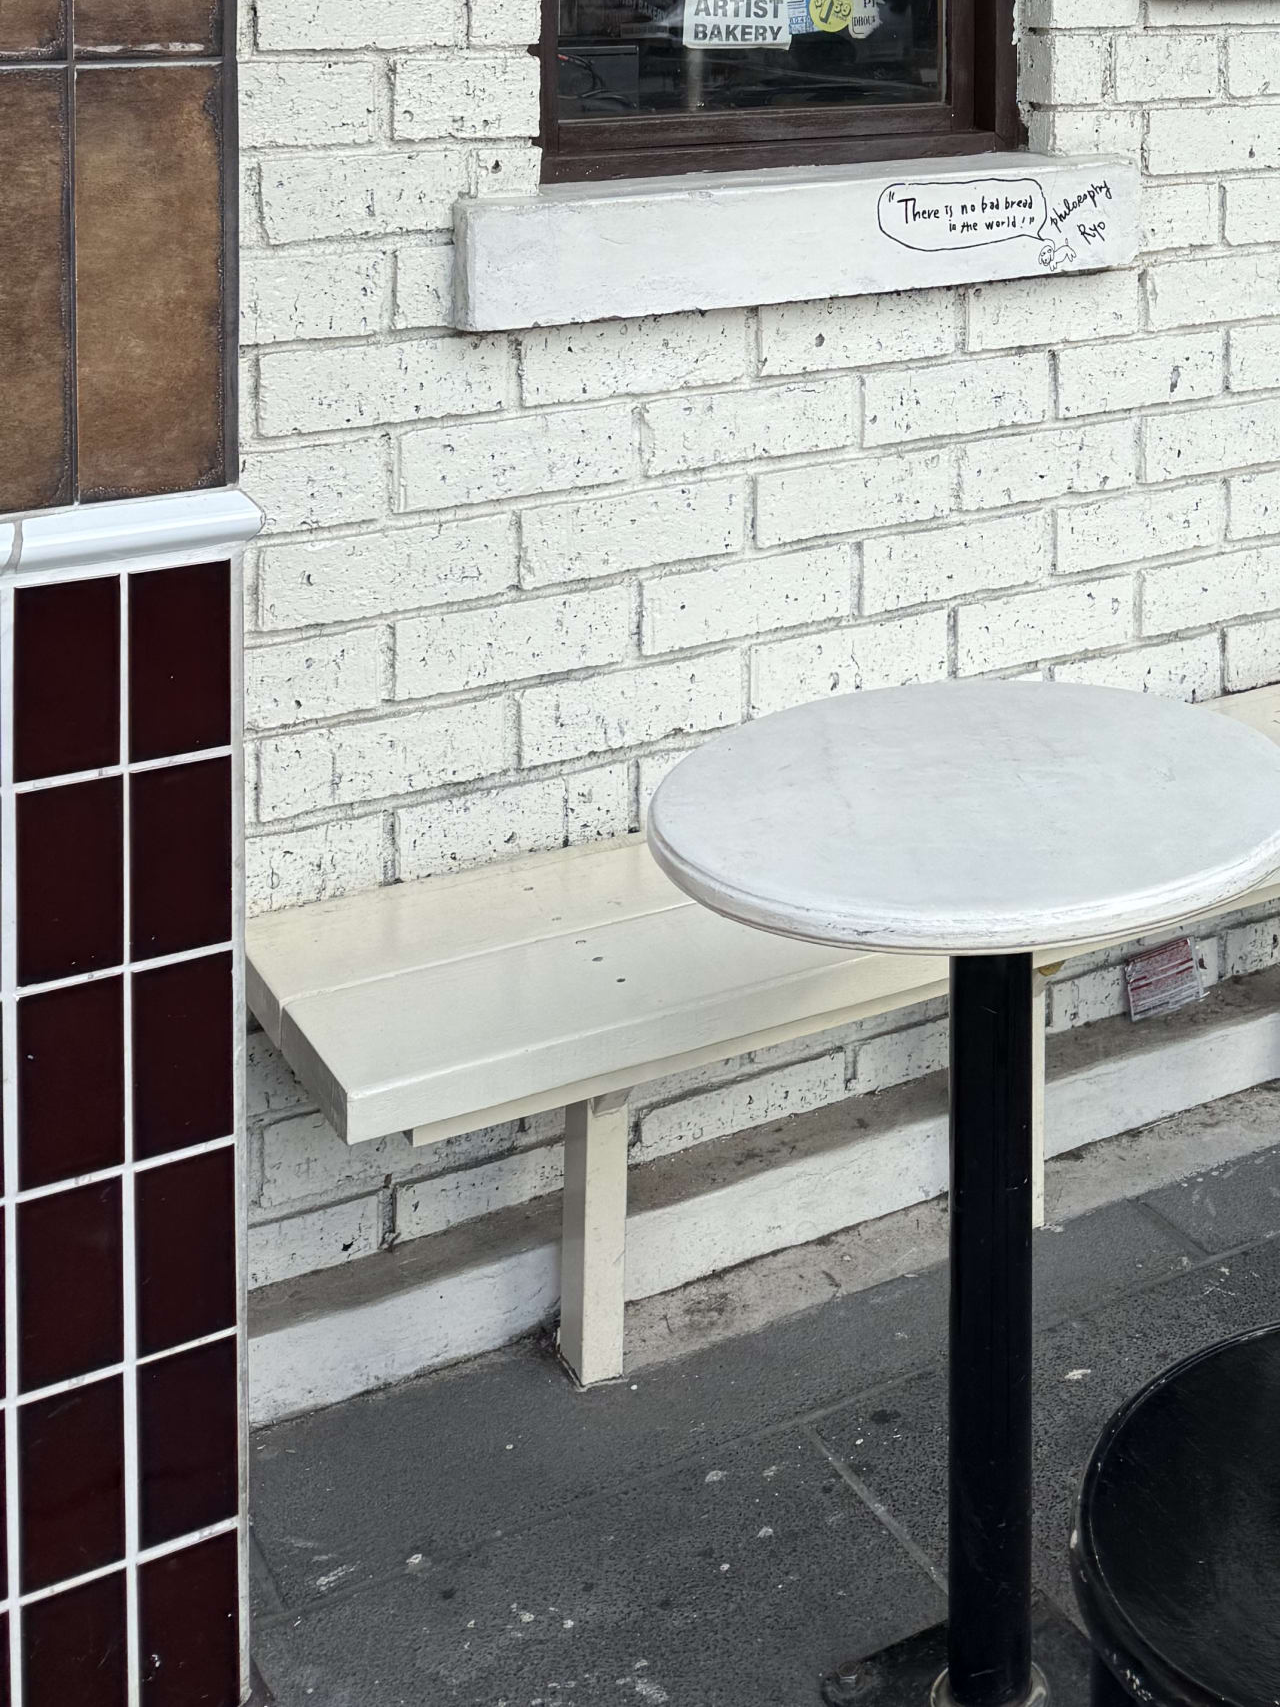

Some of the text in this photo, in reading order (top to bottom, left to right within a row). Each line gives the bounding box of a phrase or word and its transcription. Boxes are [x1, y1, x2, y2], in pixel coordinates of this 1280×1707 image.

[693, 23, 783, 42] BAKERY
[960, 203, 976, 215] no
[981, 195, 1000, 213] bad
[1004, 194, 1033, 210] bread
[949, 218, 957, 232] in
[960, 221, 978, 233] the
[1076, 221, 1106, 245] Ryo
